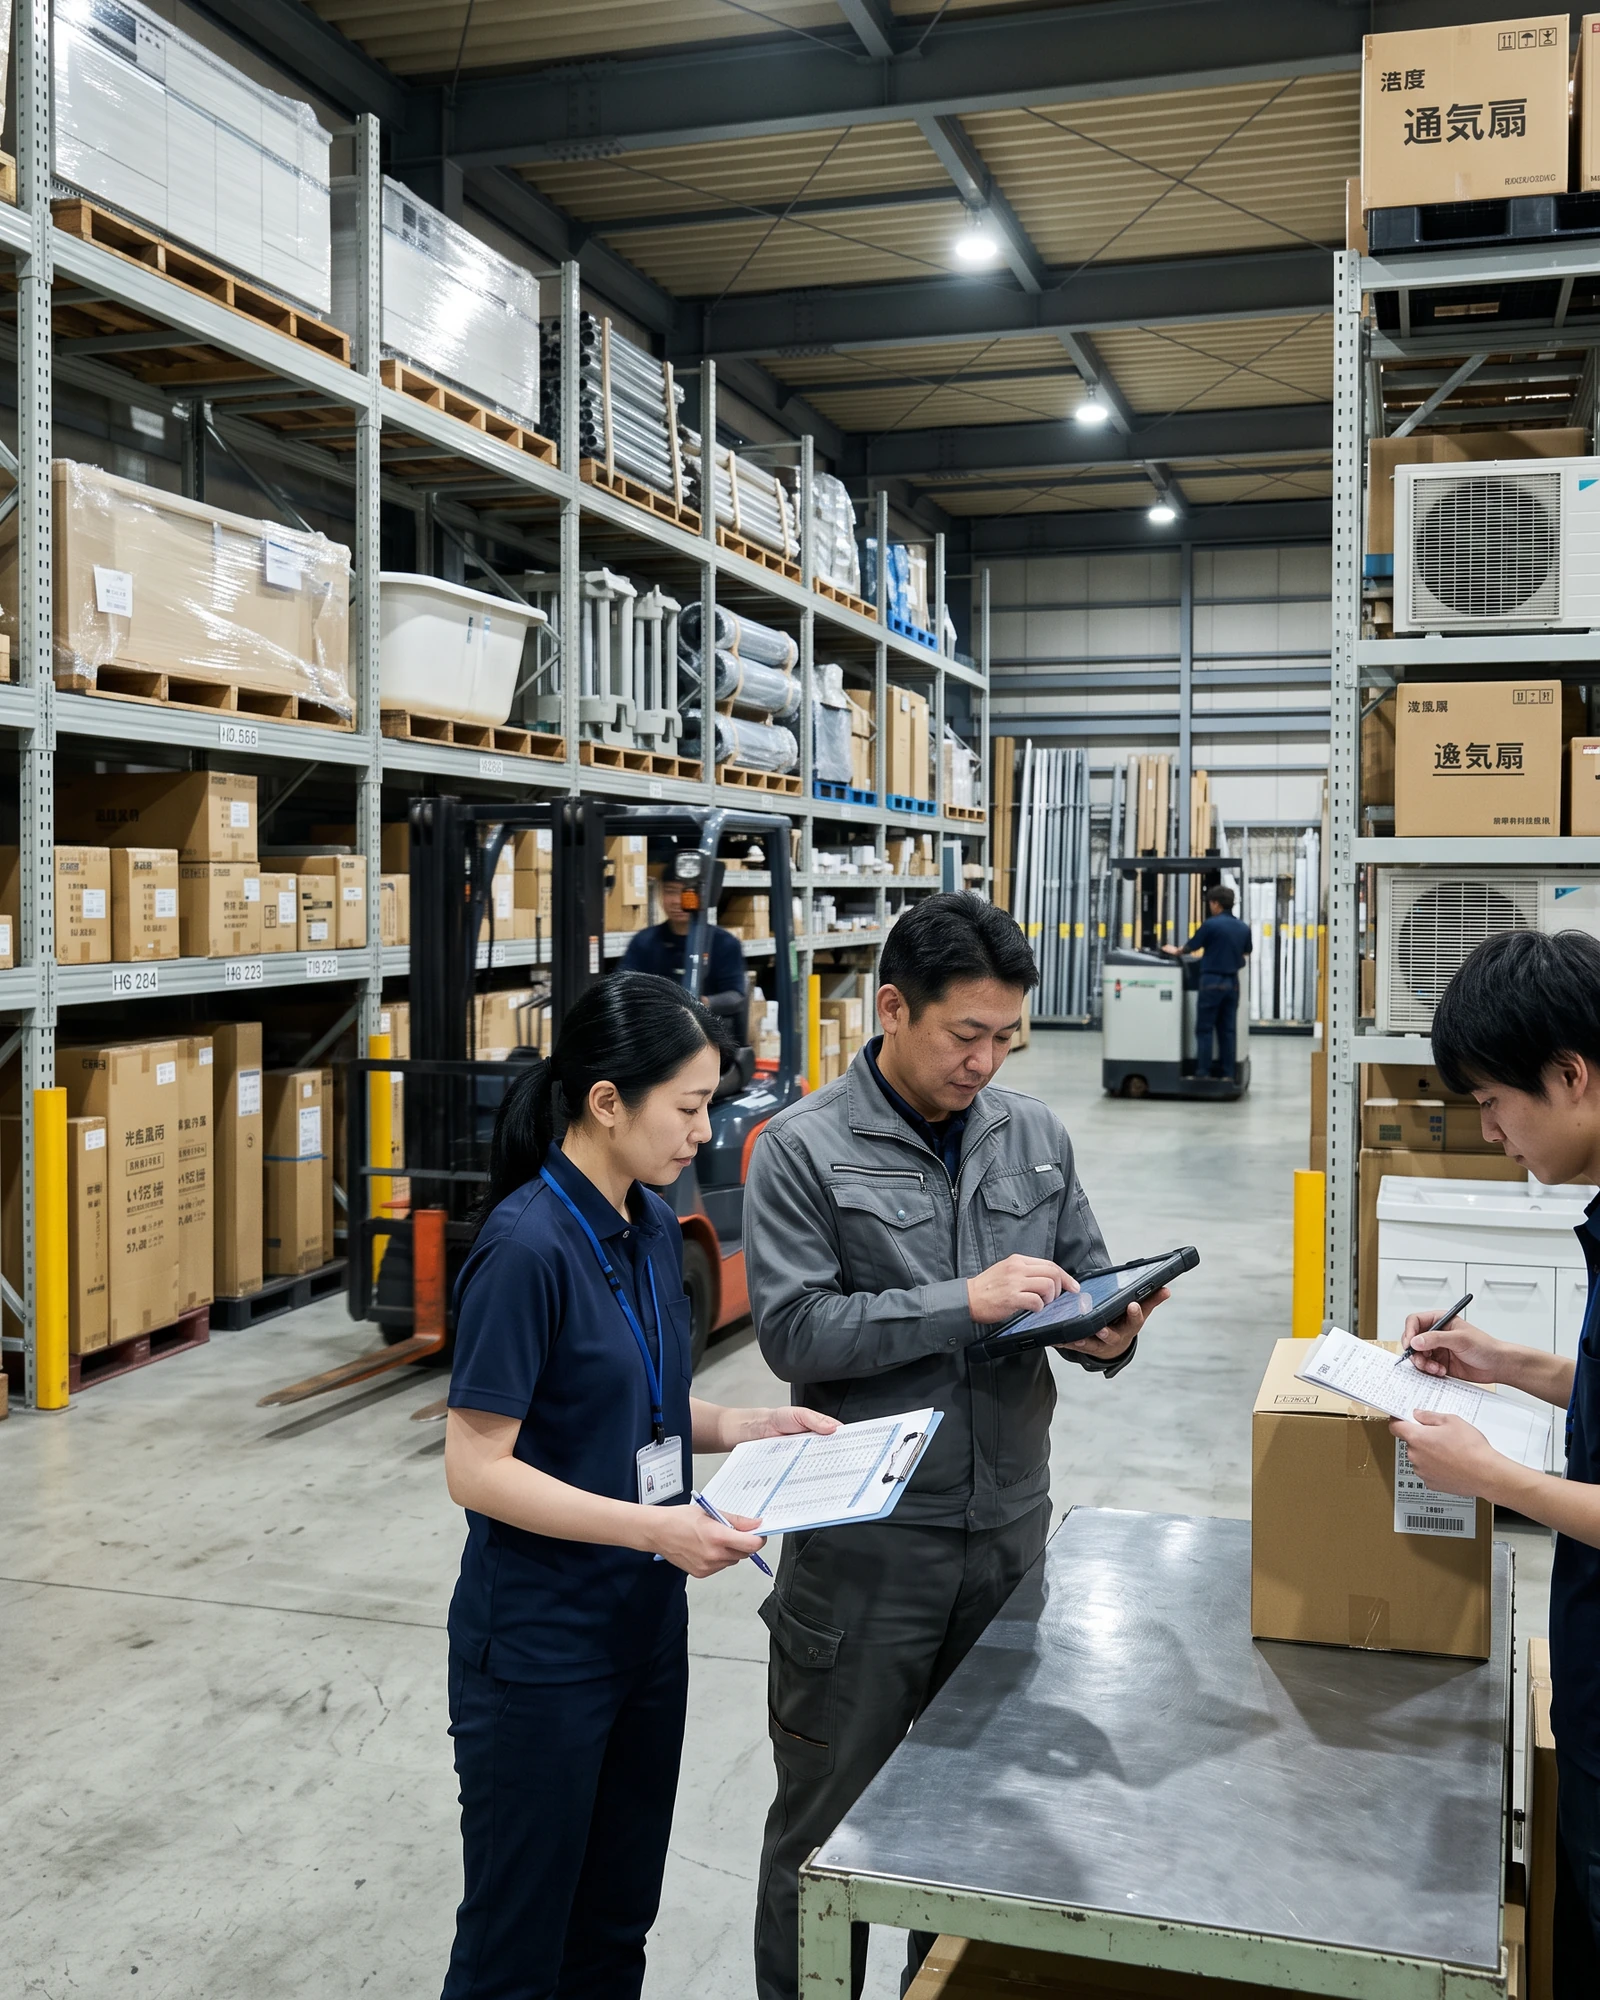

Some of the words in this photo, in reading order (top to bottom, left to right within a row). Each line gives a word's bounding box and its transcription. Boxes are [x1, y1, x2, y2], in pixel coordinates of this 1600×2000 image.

[1404, 98, 1527, 145] 通気扇
[135, 972, 156, 989] 284
